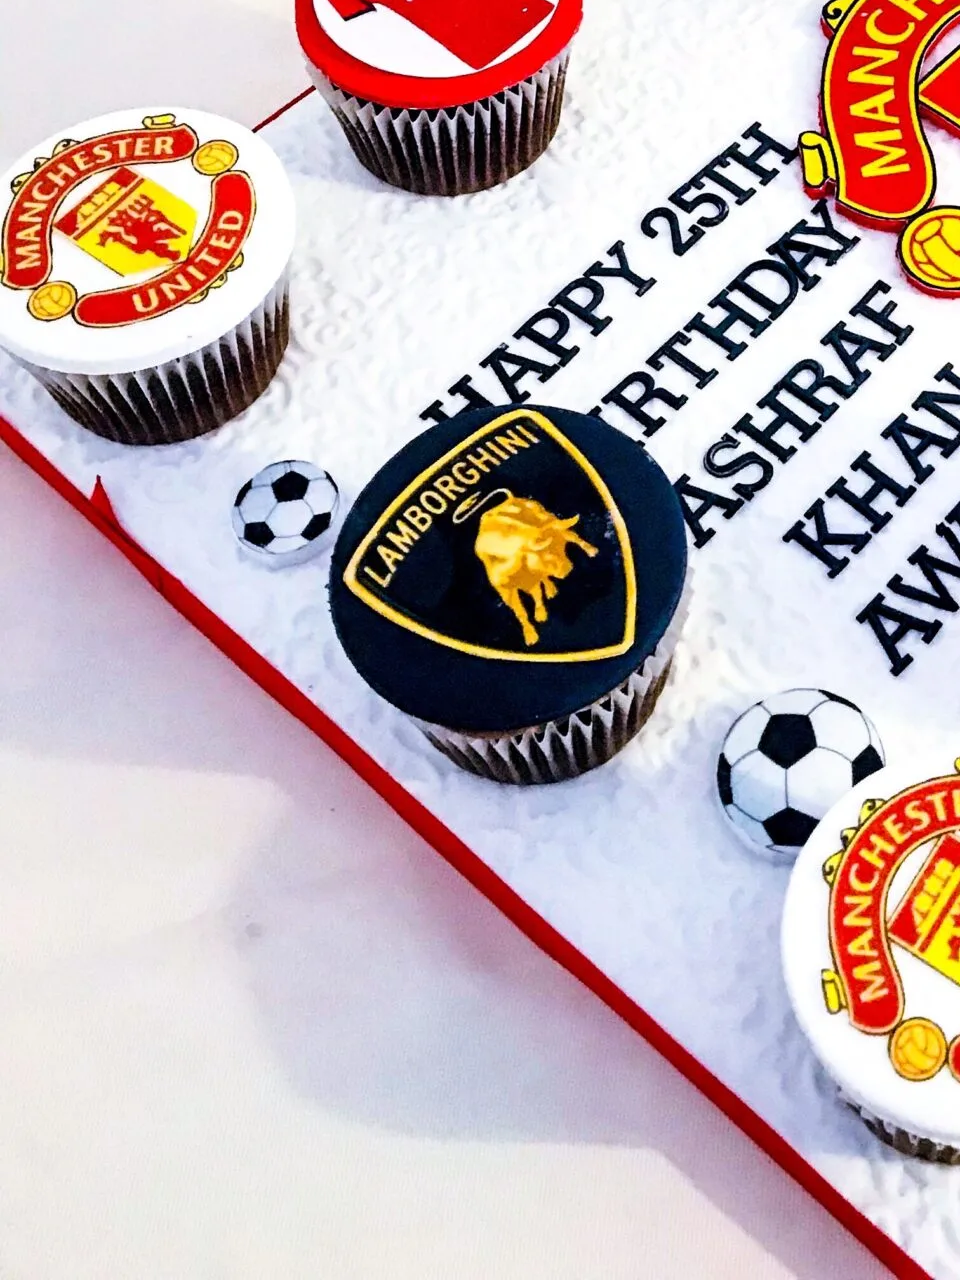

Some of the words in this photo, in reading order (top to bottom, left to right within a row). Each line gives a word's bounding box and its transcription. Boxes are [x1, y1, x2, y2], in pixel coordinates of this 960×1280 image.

[14, 135, 175, 271] MANCHESTER
[131, 209, 245, 314] UNITED
[639, 120, 801, 257] 25TH
[673, 278, 915, 549] ASHRAF
[362, 423, 542, 589] LAMBORGHINI
